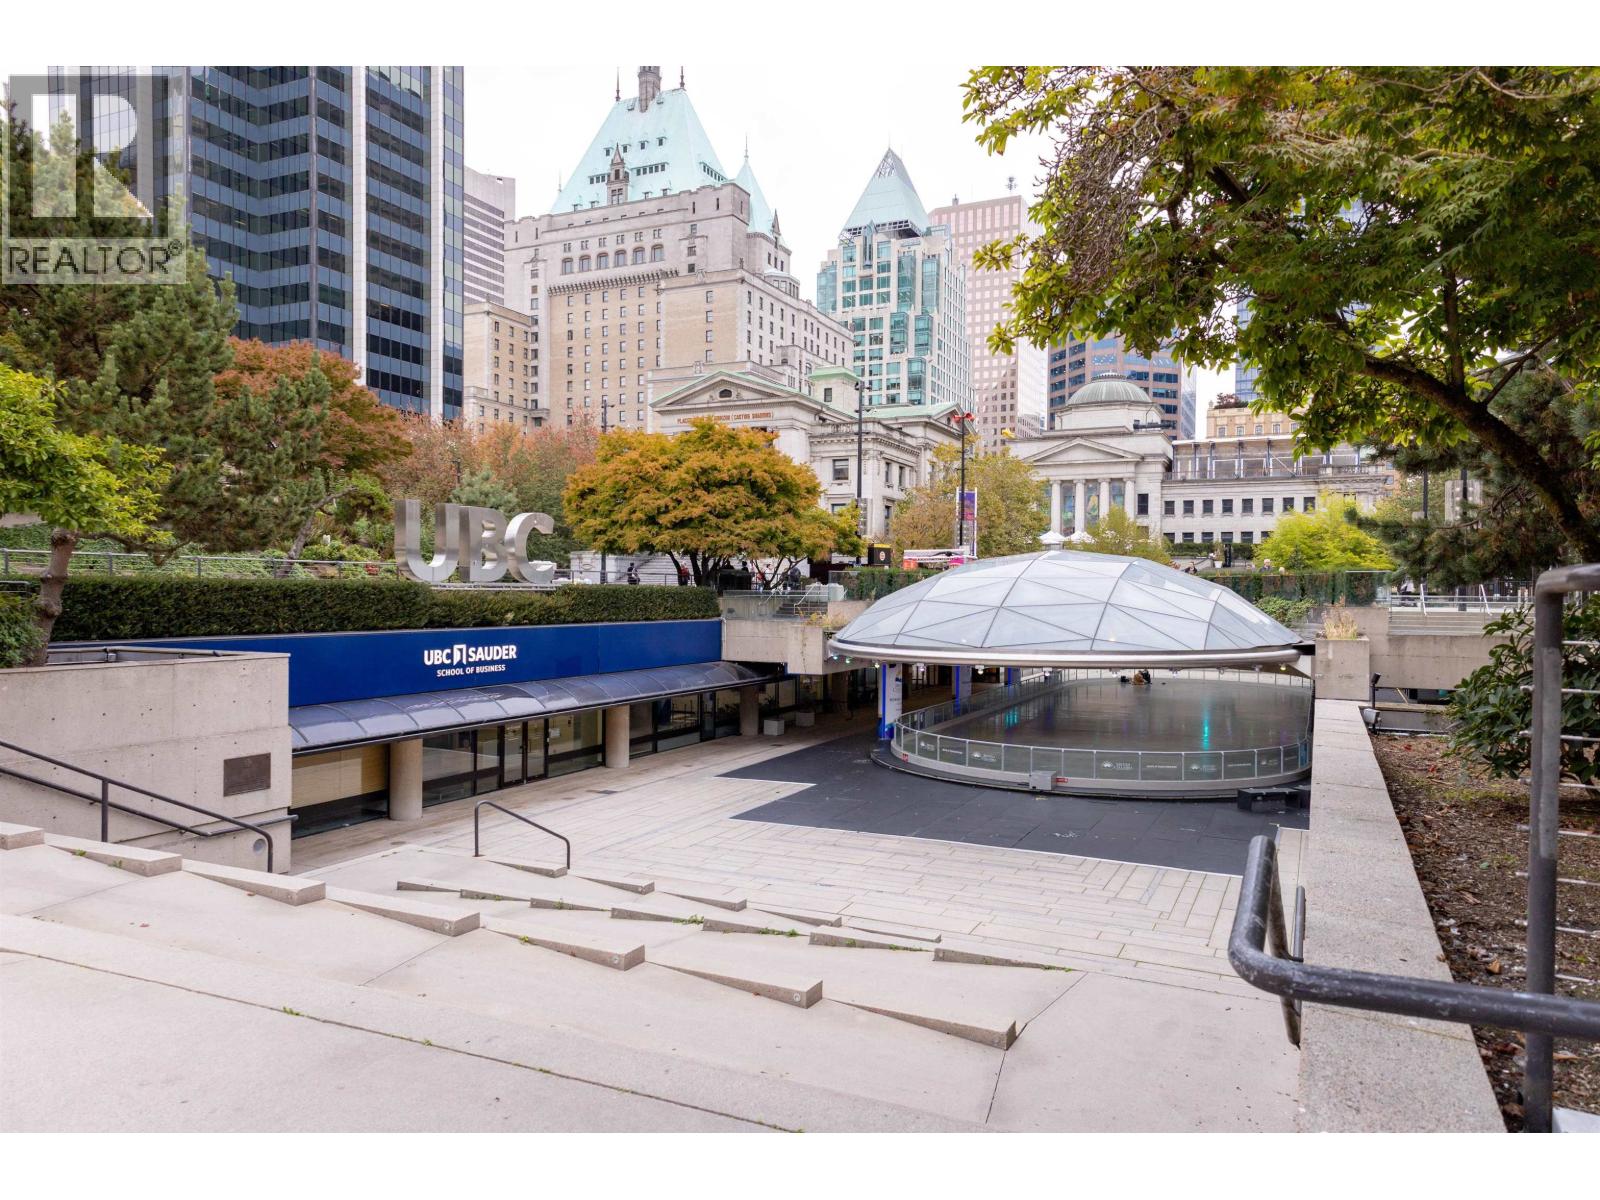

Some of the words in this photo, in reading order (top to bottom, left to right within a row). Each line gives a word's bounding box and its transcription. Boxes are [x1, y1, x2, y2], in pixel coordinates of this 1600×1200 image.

[394, 499, 555, 585] UBC
[424, 649, 452, 665] UBC
[468, 645, 517, 662] SAUDER
[436, 668, 464, 677] SCHOOL
[466, 666, 475, 675] OF
[476, 664, 506, 674] BUSINESS
